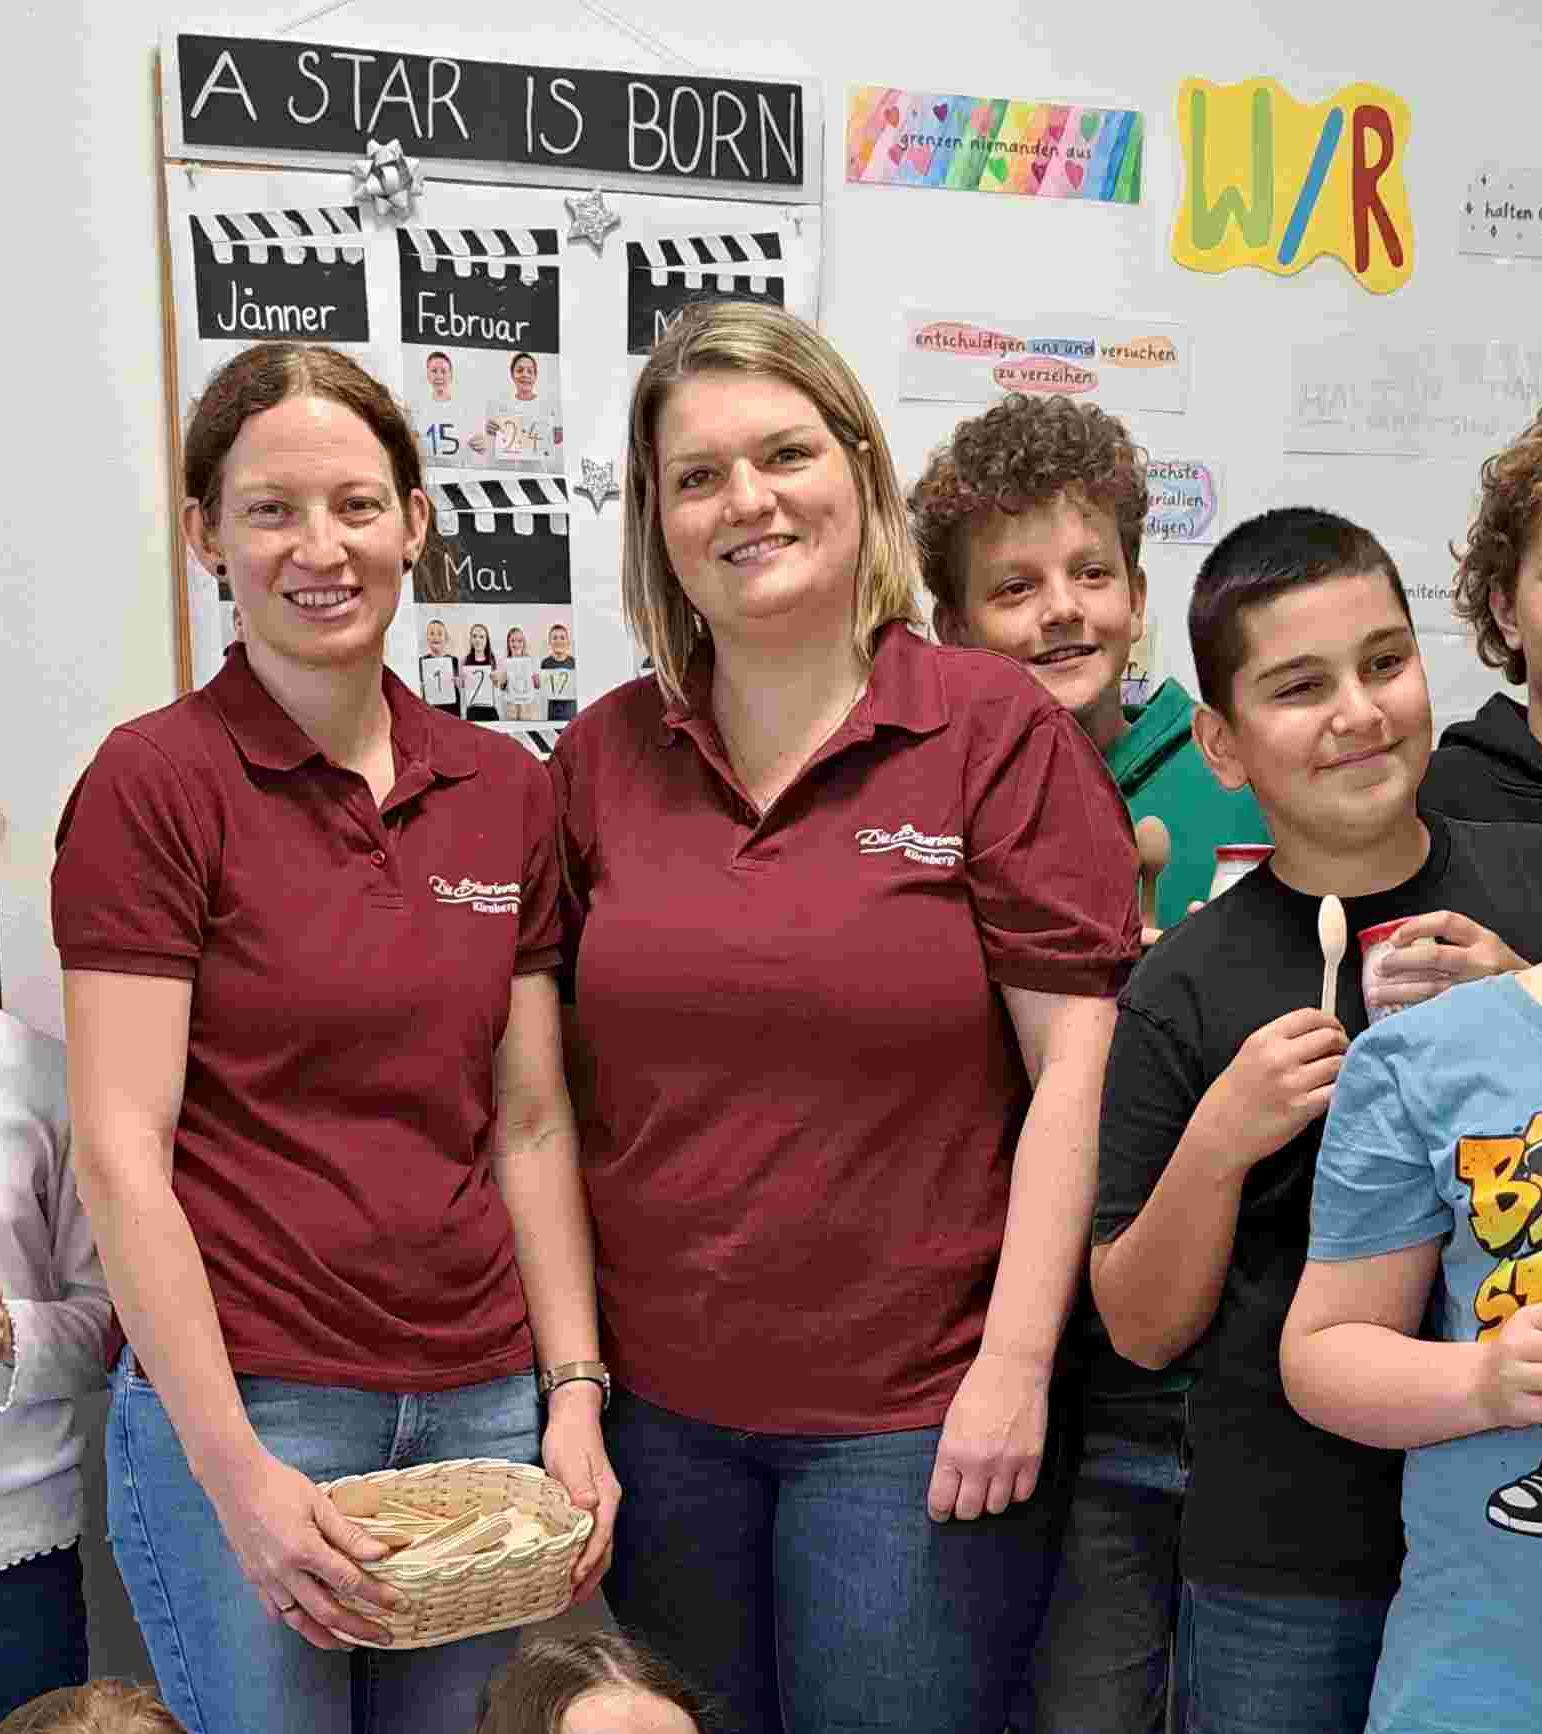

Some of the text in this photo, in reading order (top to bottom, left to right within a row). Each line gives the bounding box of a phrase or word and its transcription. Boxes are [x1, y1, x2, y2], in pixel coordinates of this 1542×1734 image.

[191, 51, 799, 178] A STAR IS BORN
[899, 133, 1091, 159] grenzen niemanden aus
[1484, 201, 1532, 220] halten
[415, 290, 531, 344] Februar
[915, 331, 1176, 362] entschuldigen uns und versuchen
[998, 367, 1092, 385] zu verzeihen
[426, 422, 460, 456] 15
[443, 553, 513, 593] Mai
